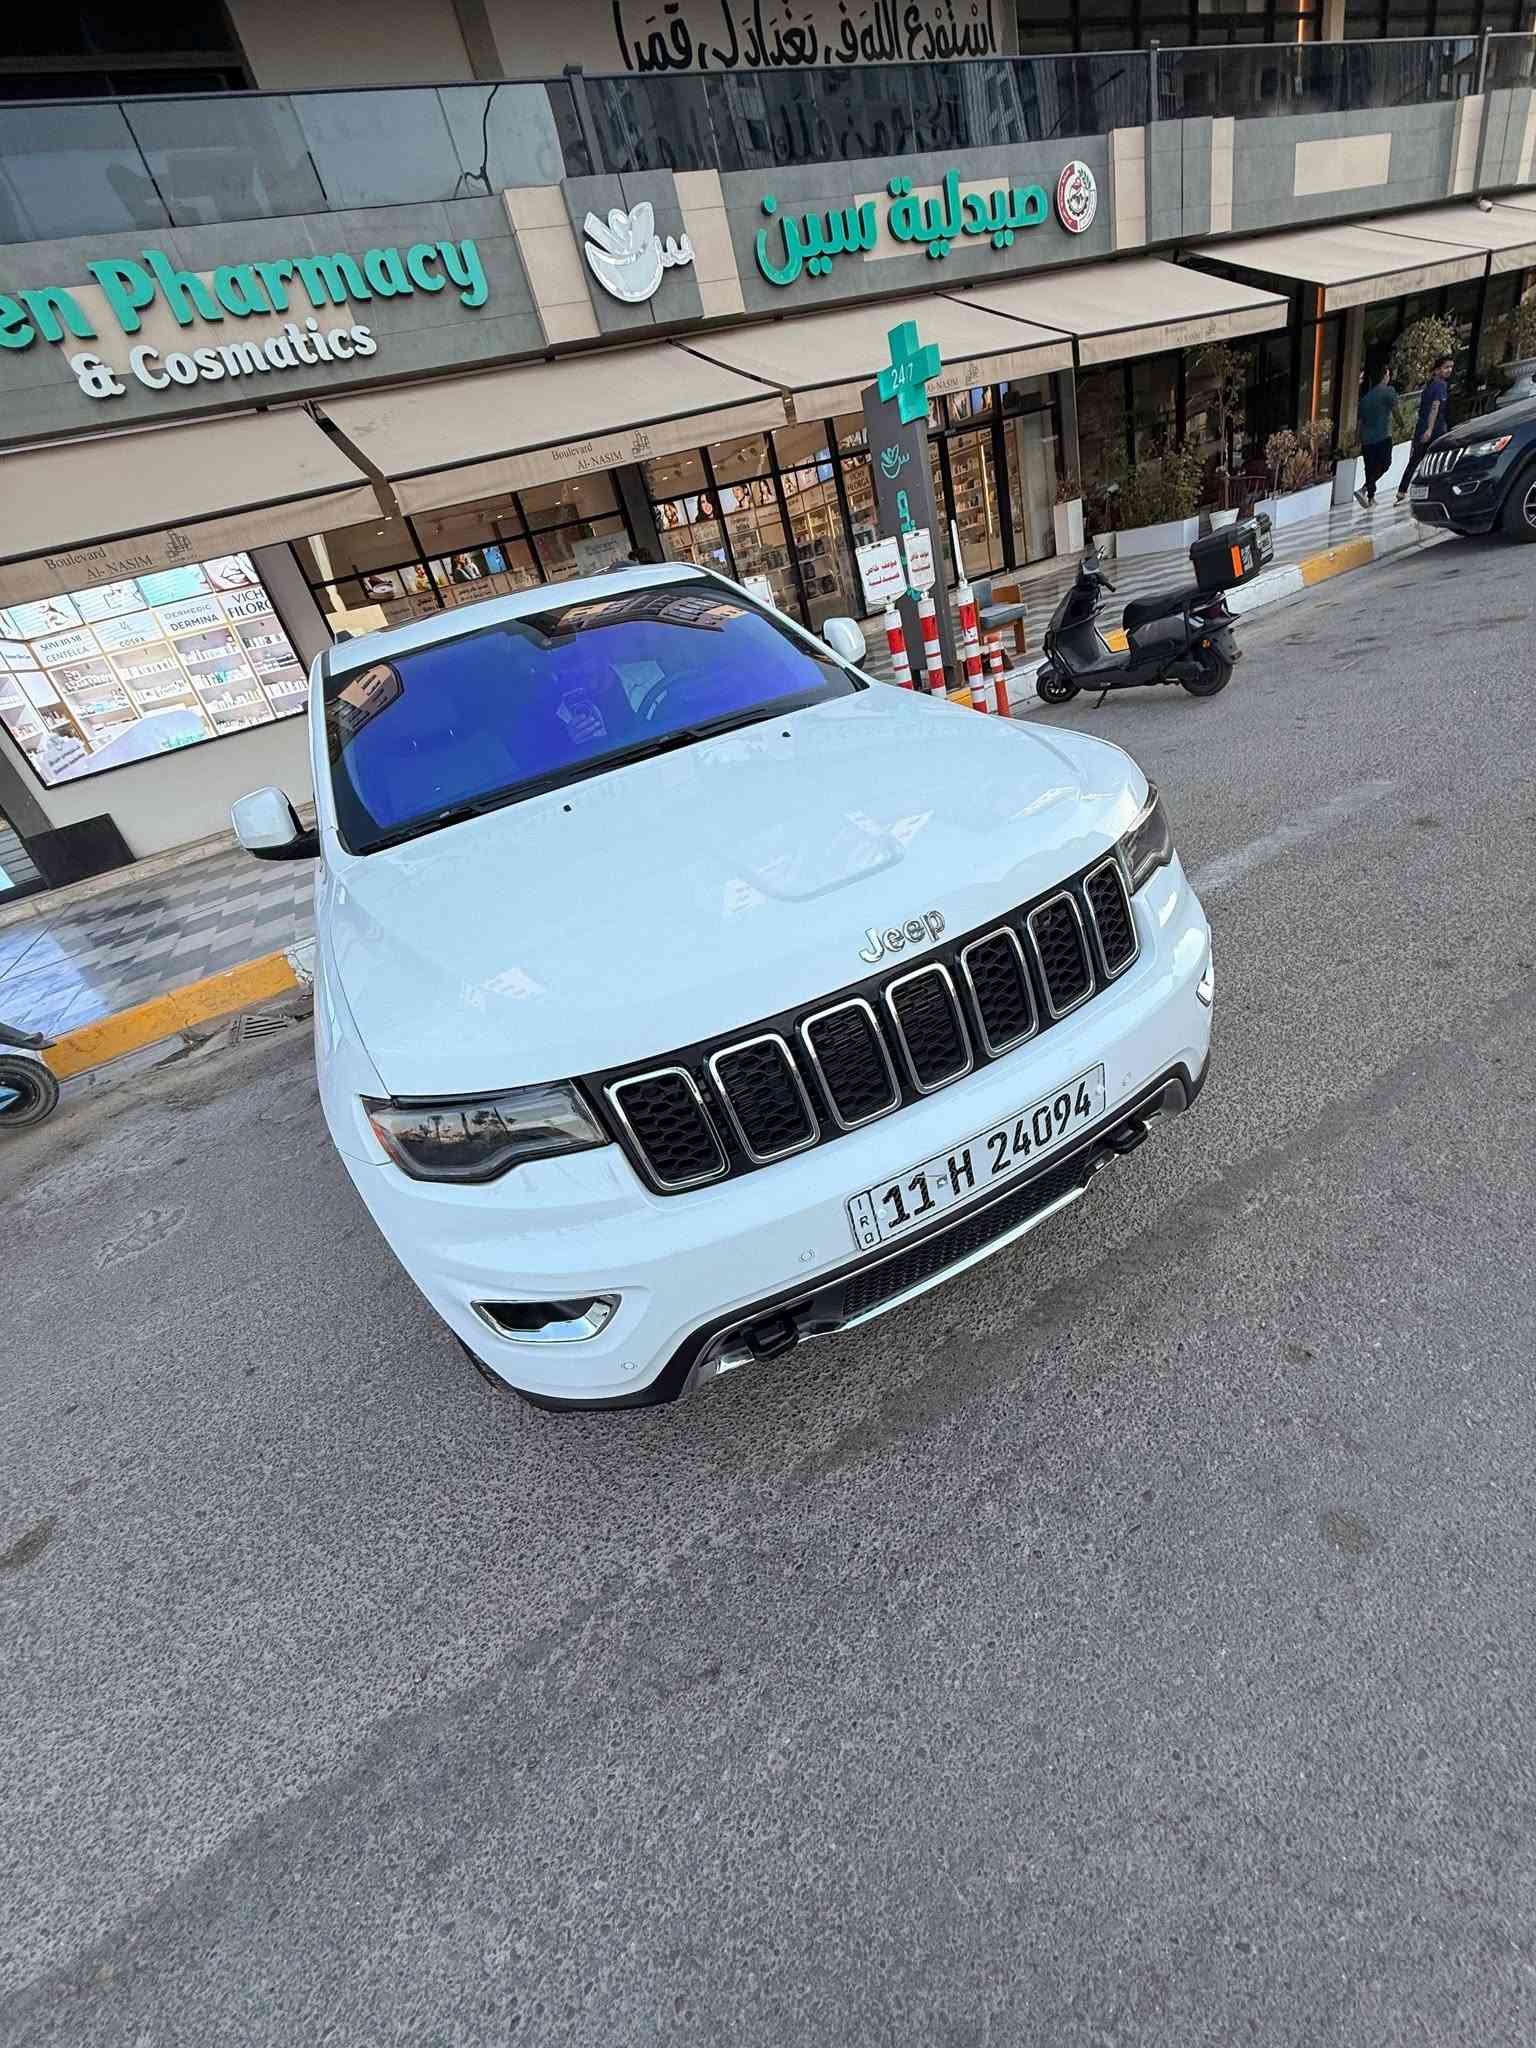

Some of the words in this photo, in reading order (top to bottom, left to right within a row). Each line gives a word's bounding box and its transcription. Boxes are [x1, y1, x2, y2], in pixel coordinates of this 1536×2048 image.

[755, 193, 879, 287] سين
[888, 169, 1050, 260] صيدلية
[87, 238, 490, 335] Pharmacy
[69, 351, 126, 399] &
[128, 316, 378, 390] Cosmatics
[551, 441, 593, 461] Boulevard
[43, 545, 107, 570] Boulevard
[170, 613, 220, 632] DERMINA
[859, 909, 946, 963] Jeep
[947, 1148, 976, 1196] H
[986, 1081, 1092, 1176] 24094
